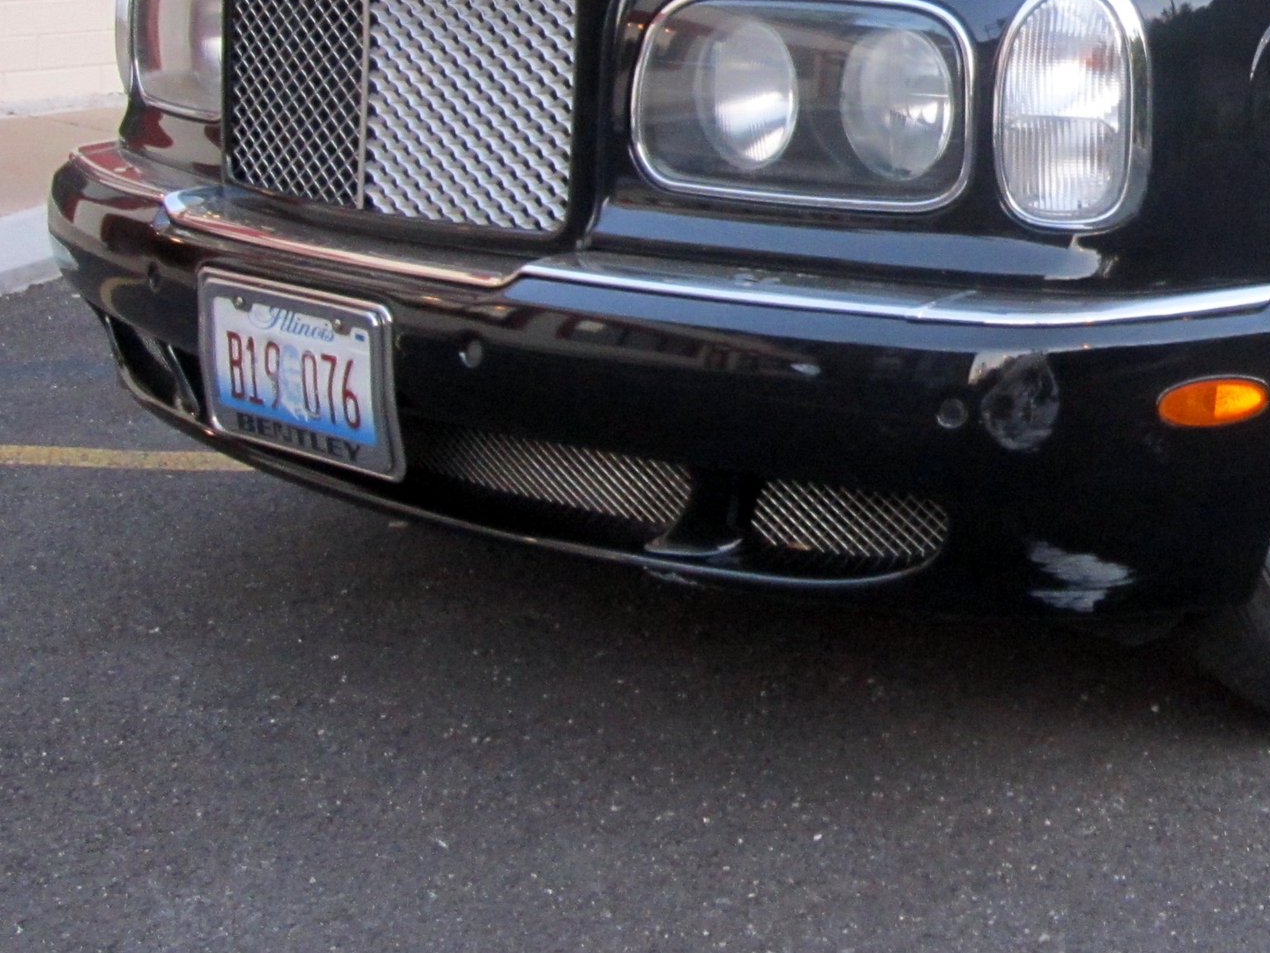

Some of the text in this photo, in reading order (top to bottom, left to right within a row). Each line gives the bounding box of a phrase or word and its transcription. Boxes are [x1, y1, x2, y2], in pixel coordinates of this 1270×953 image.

[249, 306, 335, 342] Illinois
[226, 329, 361, 429] B19 076
[236, 411, 361, 461] BENTLEY
